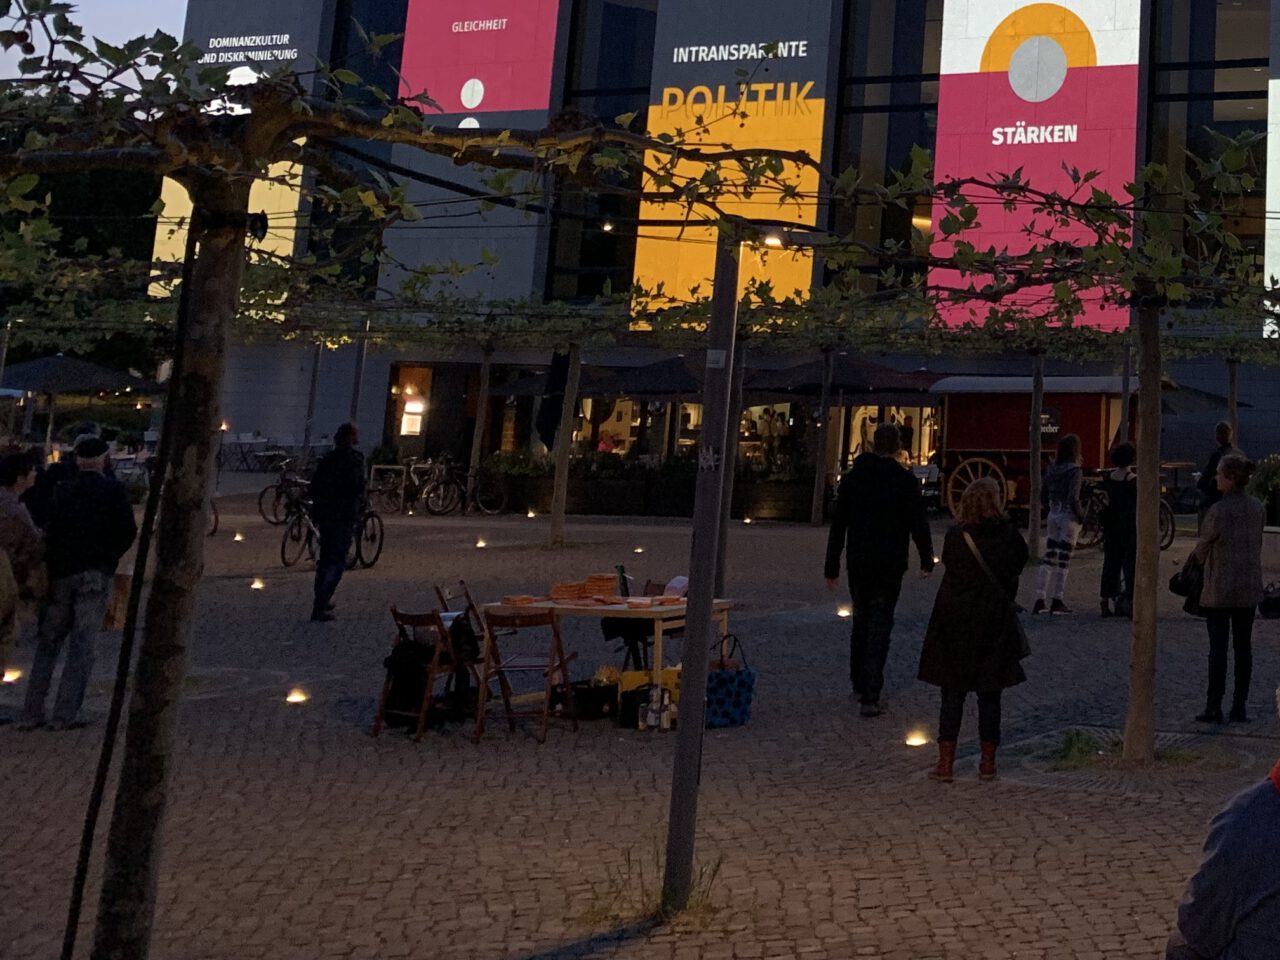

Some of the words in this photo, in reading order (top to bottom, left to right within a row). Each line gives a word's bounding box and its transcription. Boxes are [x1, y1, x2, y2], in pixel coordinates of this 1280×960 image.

[451, 18, 508, 33] GLEICHHEIT
[208, 34, 290, 48] DOMINANZKULTUR
[673, 41, 808, 63] INTRANSPARNTE
[659, 81, 815, 119] POLITIK
[992, 121, 1078, 145] STÄRKEN
